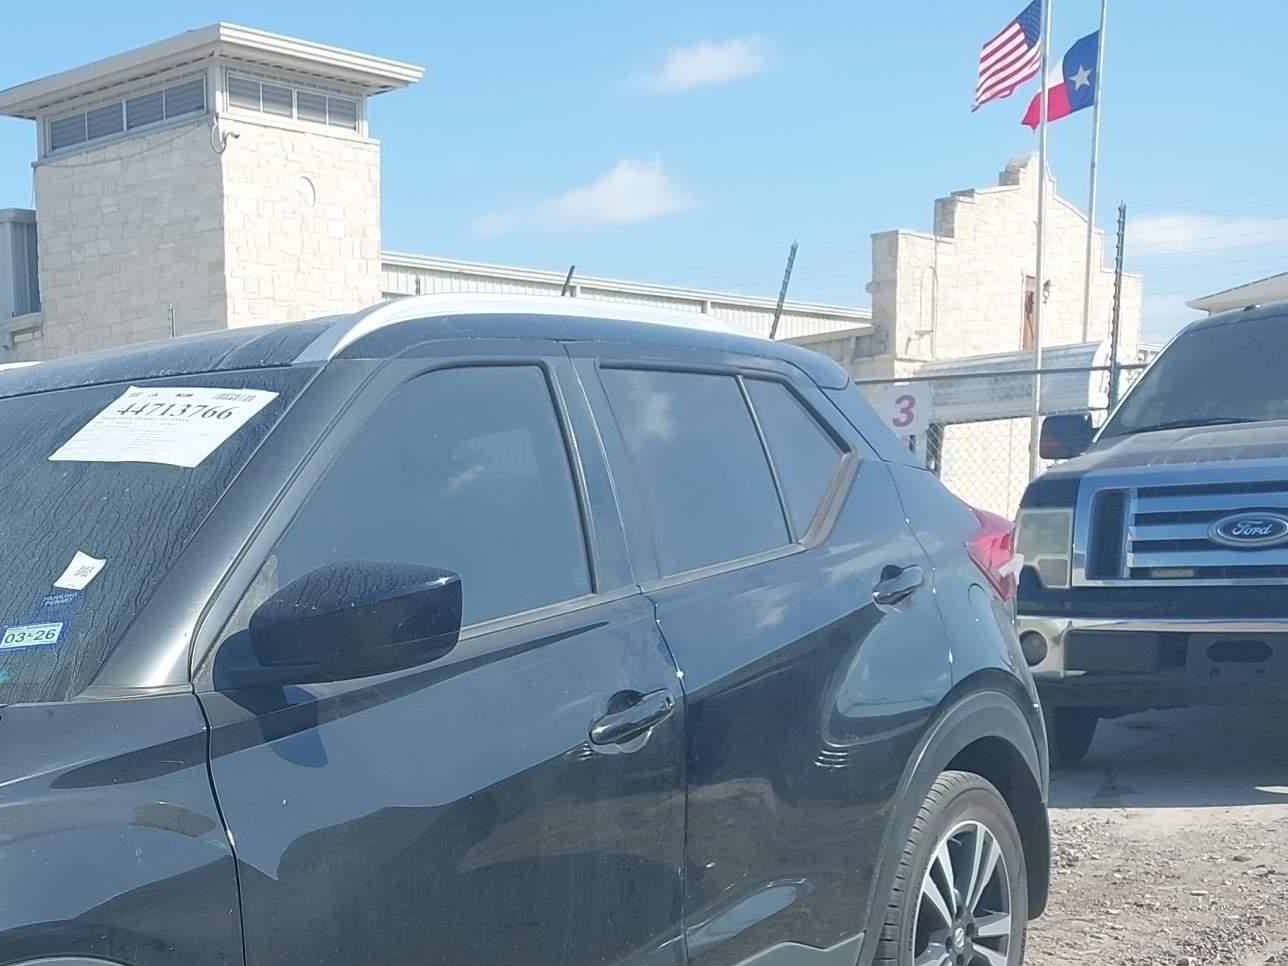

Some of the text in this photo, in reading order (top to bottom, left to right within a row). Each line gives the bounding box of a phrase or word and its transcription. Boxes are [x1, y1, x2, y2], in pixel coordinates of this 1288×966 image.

[116, 402, 240, 420] 44713766
[892, 395, 916, 427] 3
[1232, 520, 1273, 536] Ford
